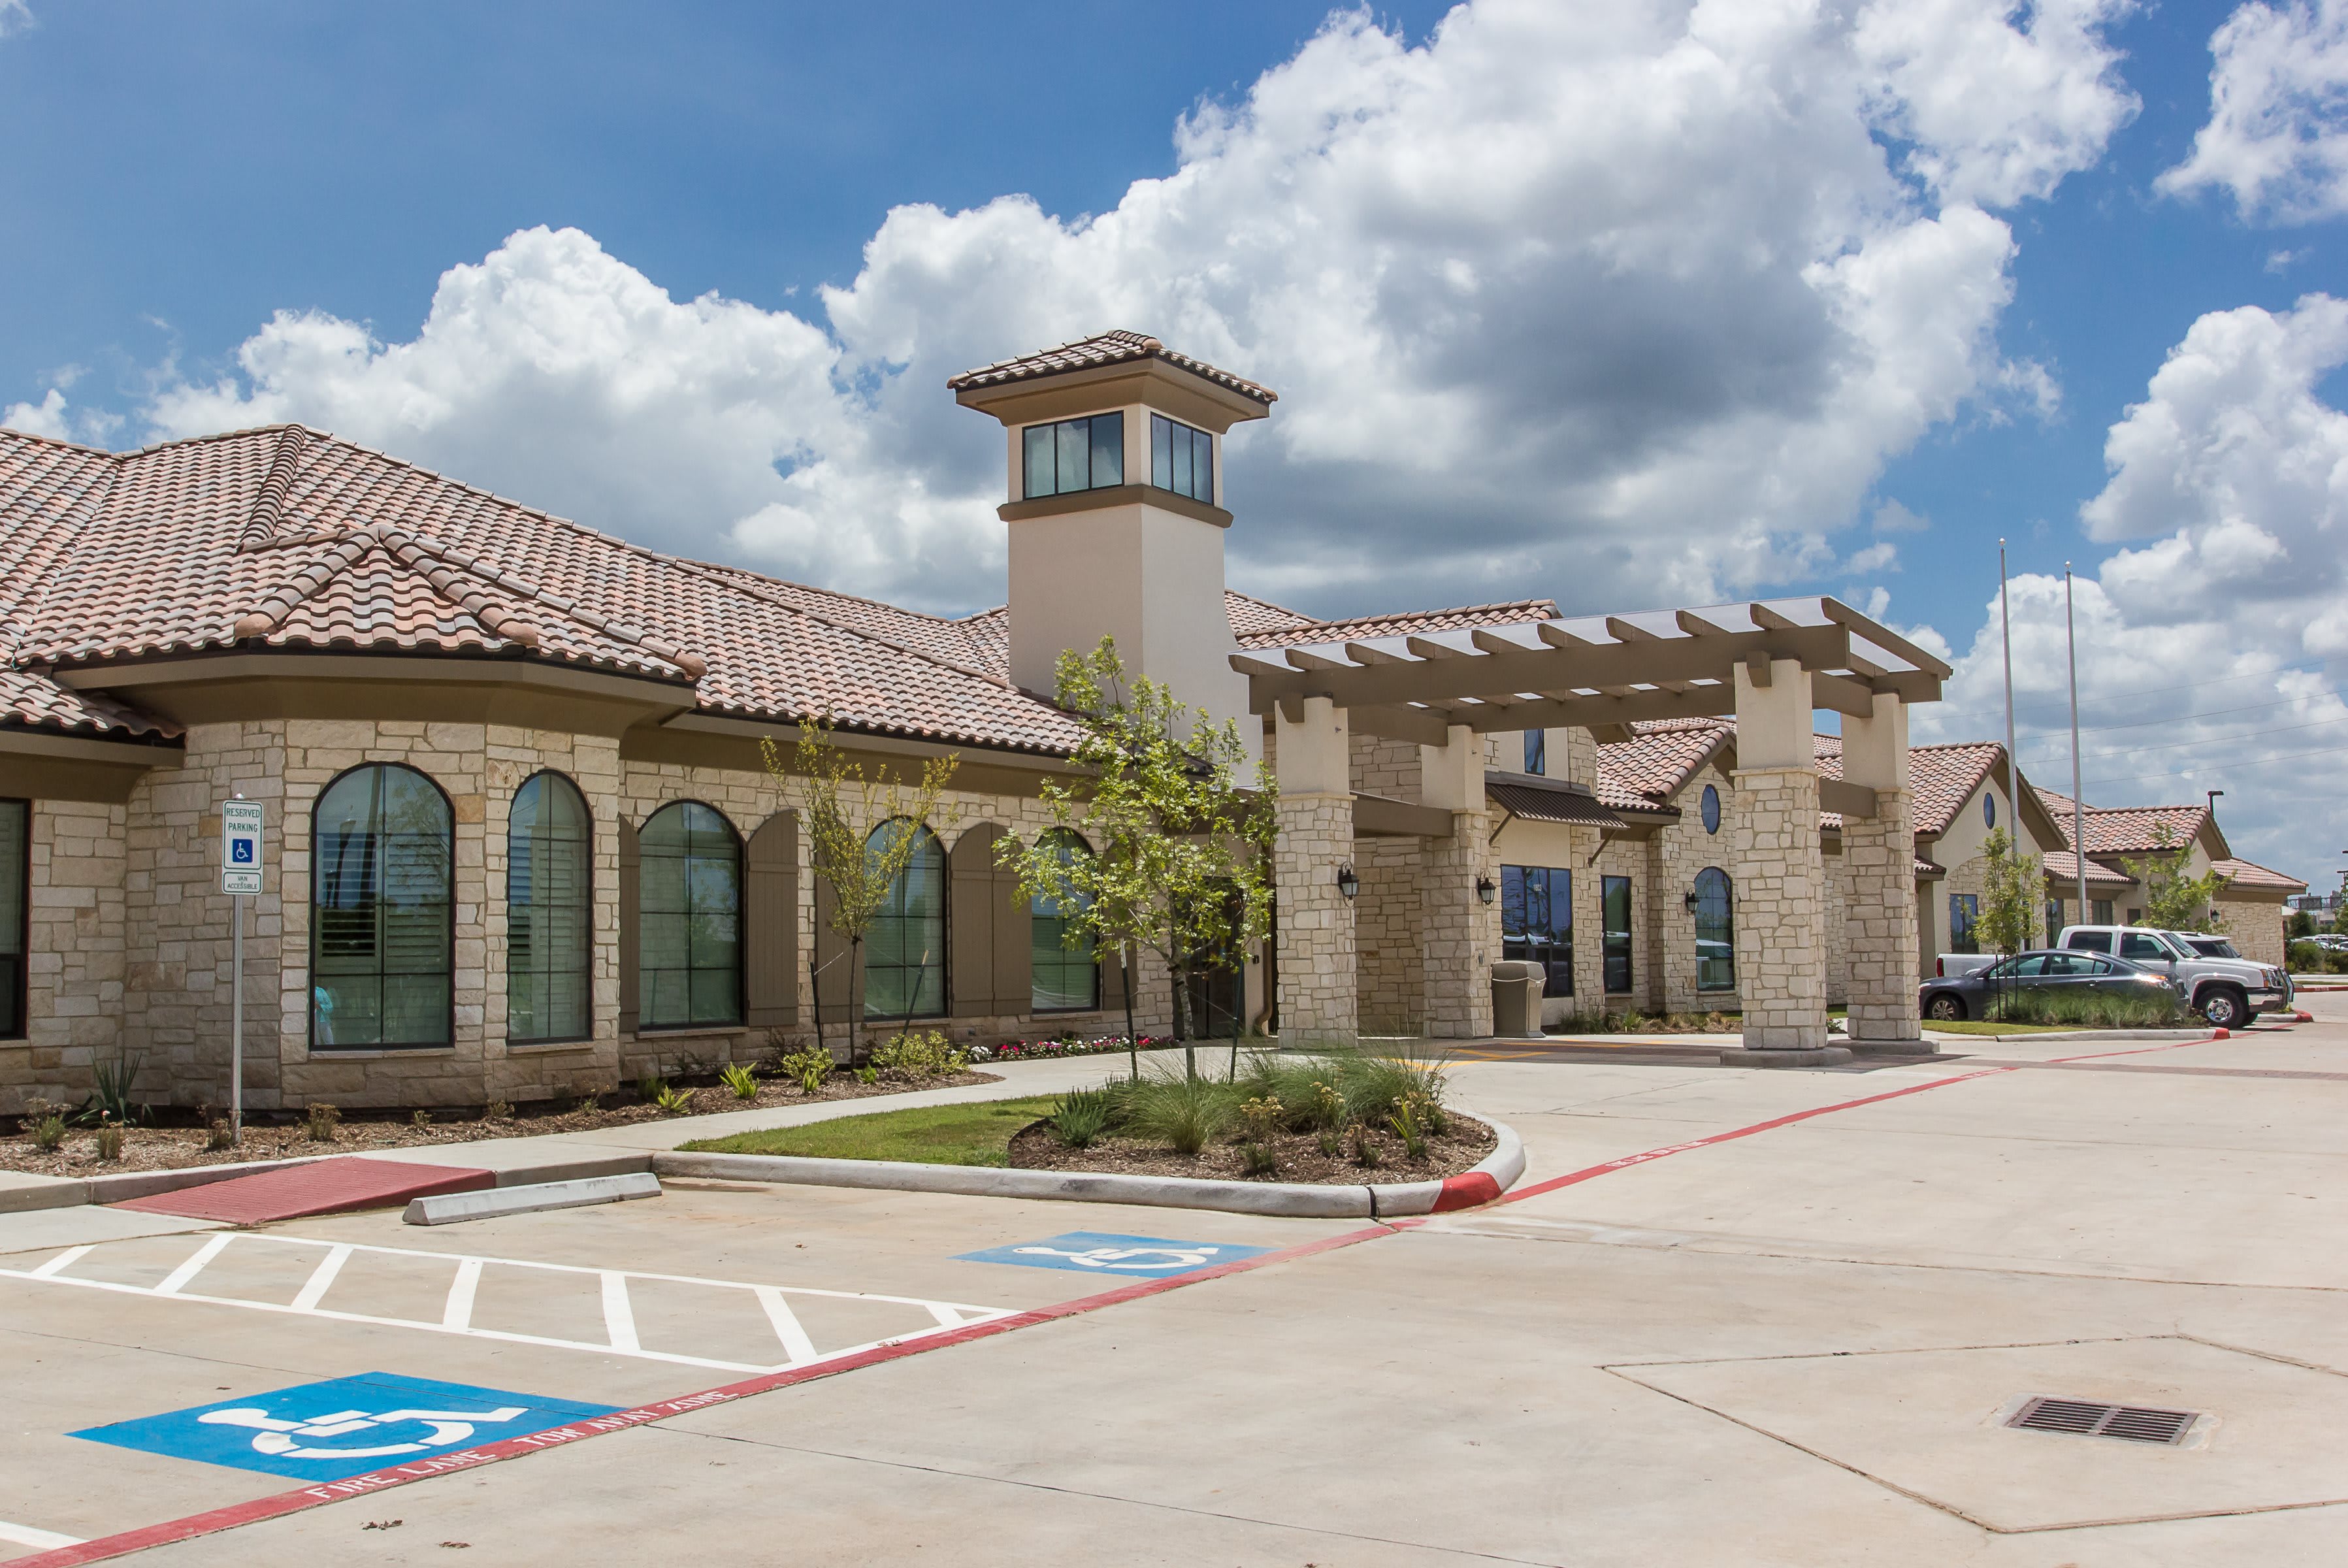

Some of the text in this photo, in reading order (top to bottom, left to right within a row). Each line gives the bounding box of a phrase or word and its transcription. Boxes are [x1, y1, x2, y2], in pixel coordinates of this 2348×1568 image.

[226, 808, 260, 818] RESERVED
[228, 823, 257, 832] PARKING
[304, 1390, 740, 1499] FIRE LANE TOW AWAY ZONE
